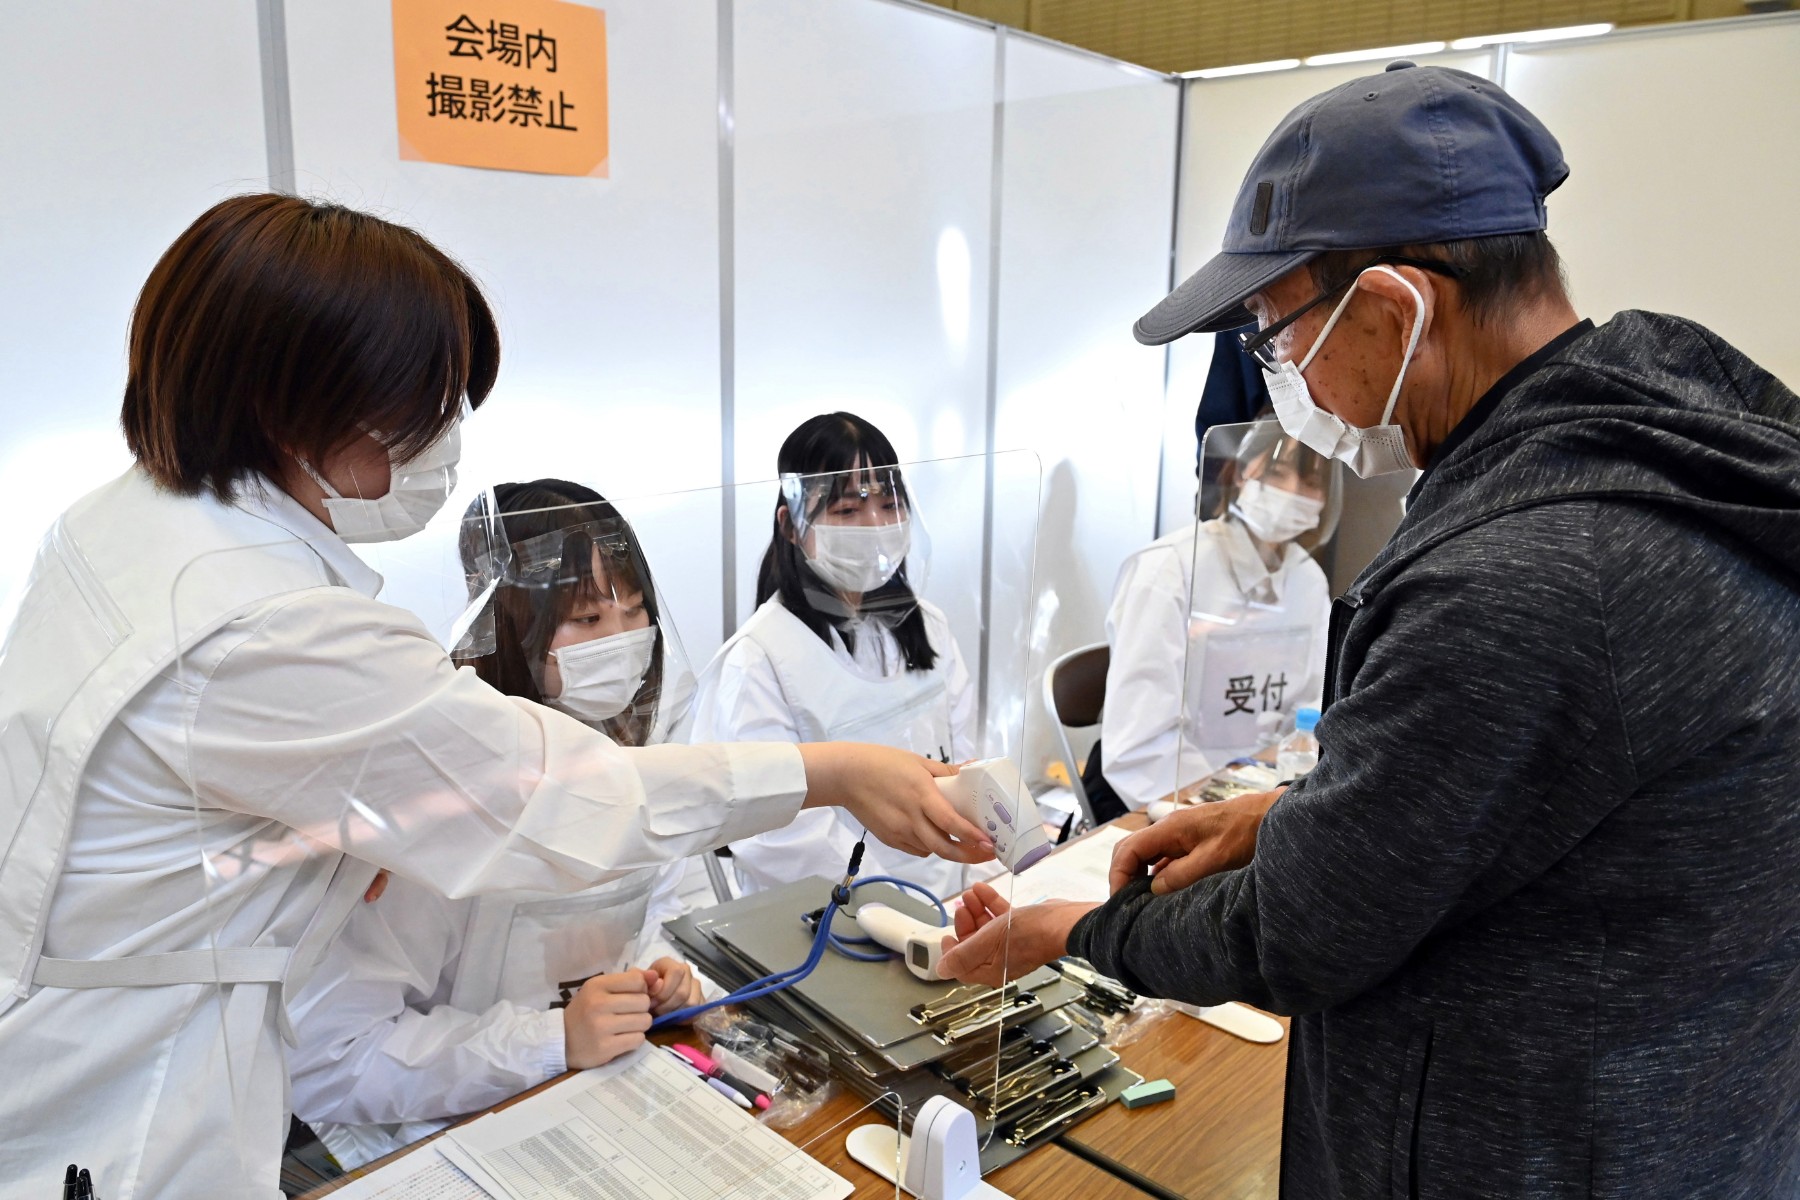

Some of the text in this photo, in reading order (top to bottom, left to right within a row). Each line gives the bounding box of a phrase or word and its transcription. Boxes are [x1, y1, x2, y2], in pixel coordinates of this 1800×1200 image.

[445, 14, 557, 73] 会場内
[426, 72, 578, 131] 撮影禁止
[1224, 673, 1288, 716] 受付
